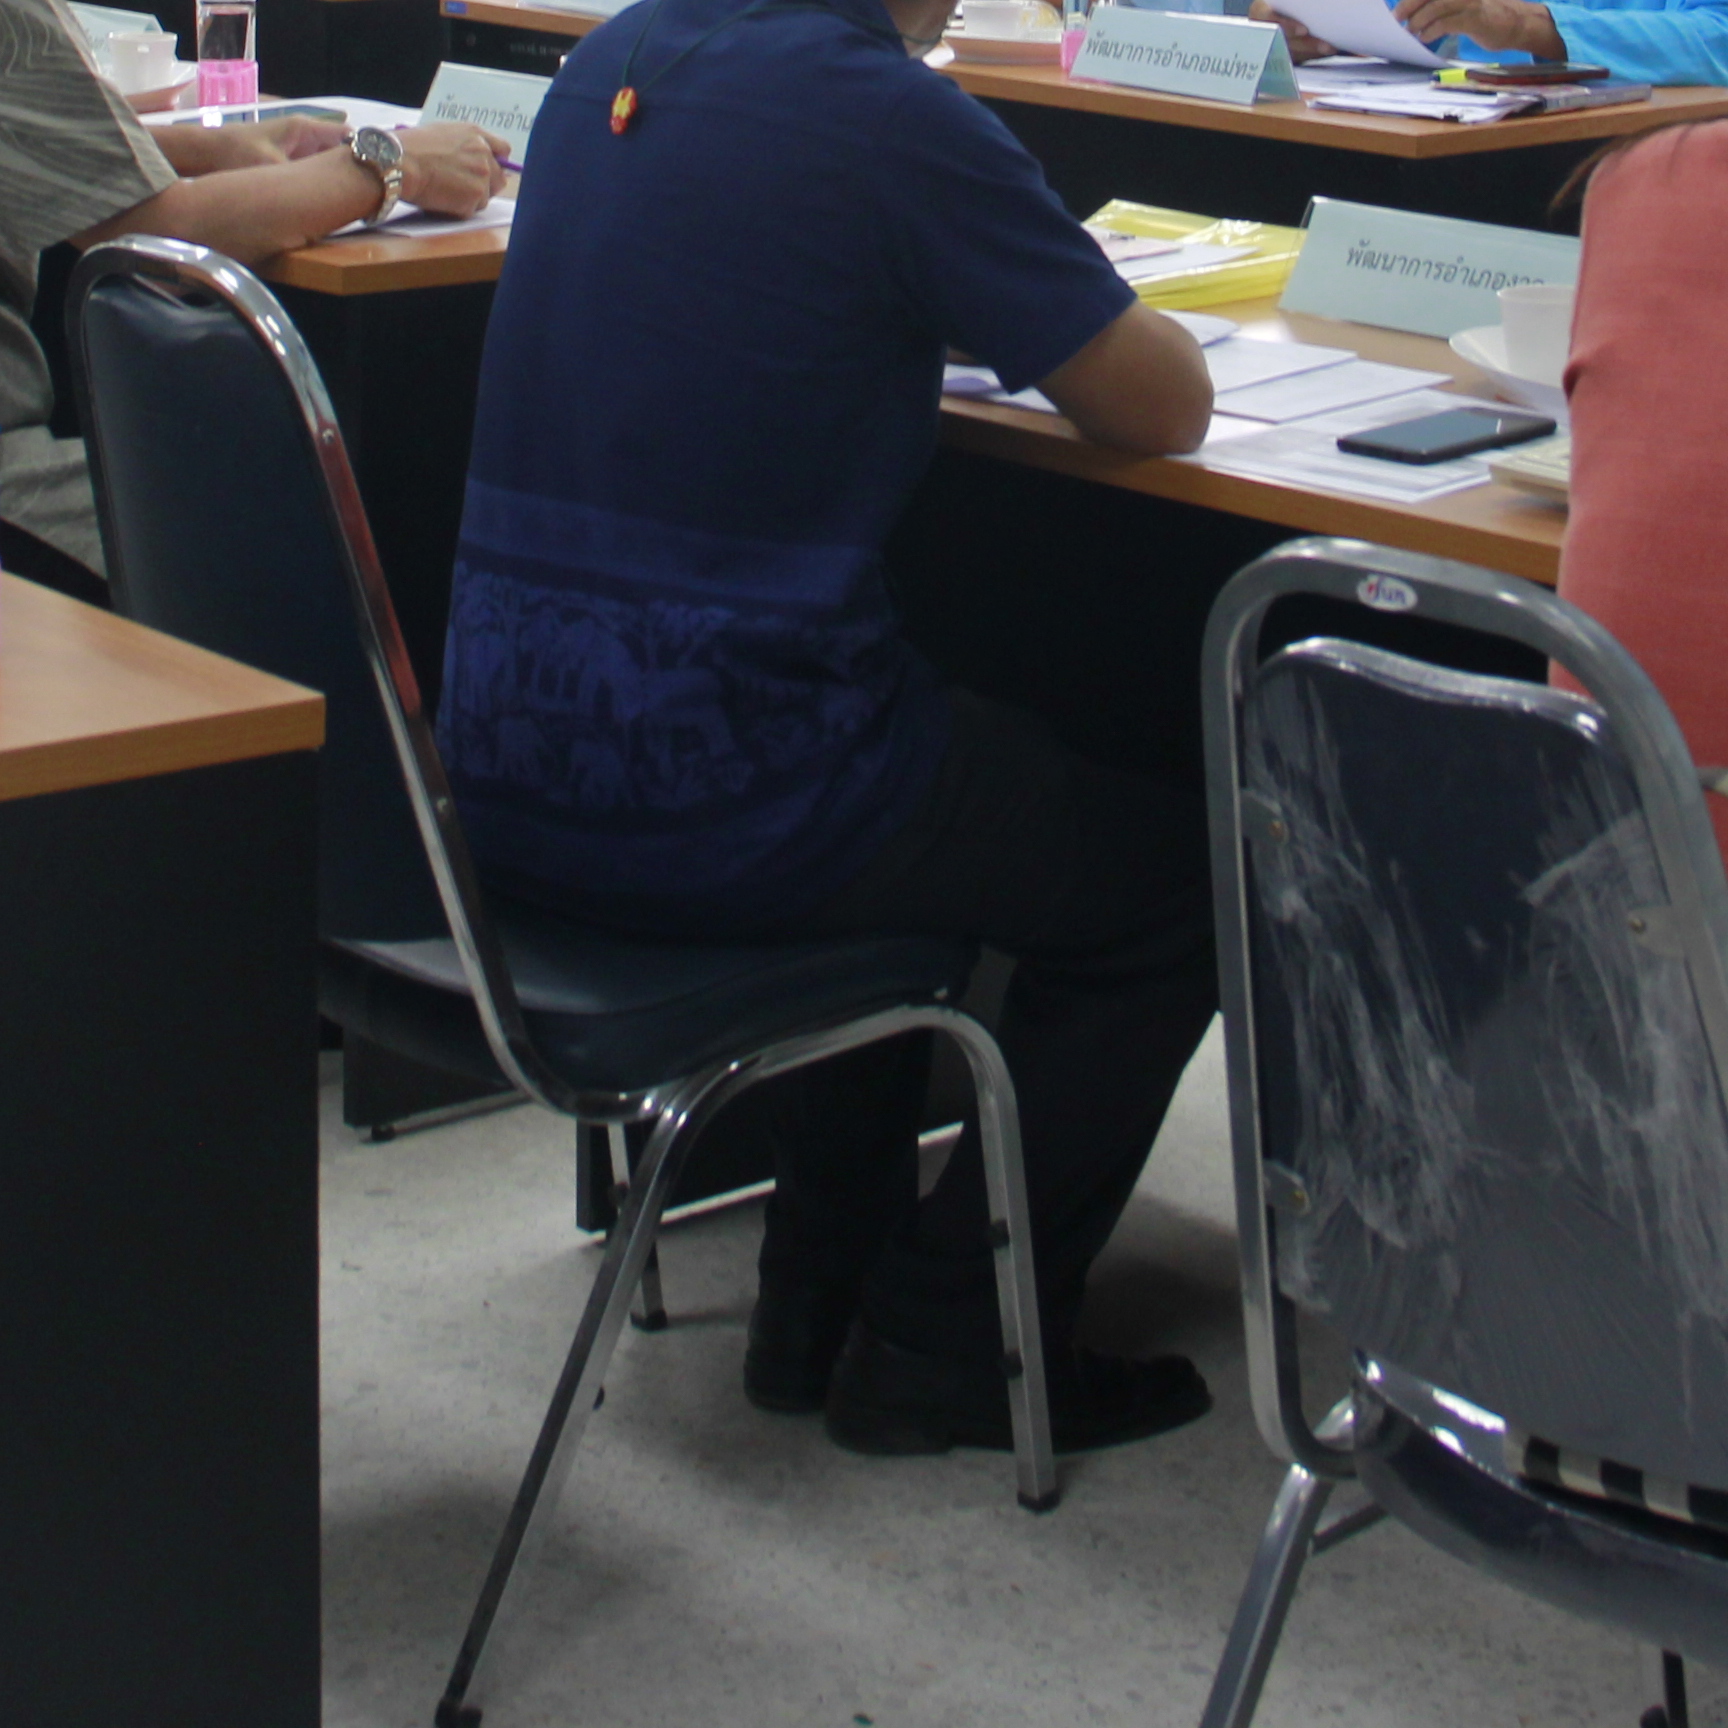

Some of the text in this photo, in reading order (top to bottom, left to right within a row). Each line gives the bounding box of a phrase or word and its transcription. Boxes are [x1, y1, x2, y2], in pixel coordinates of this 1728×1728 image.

[1085, 29, 1259, 81] พัฒนาการอำเภอแม่ทะ
